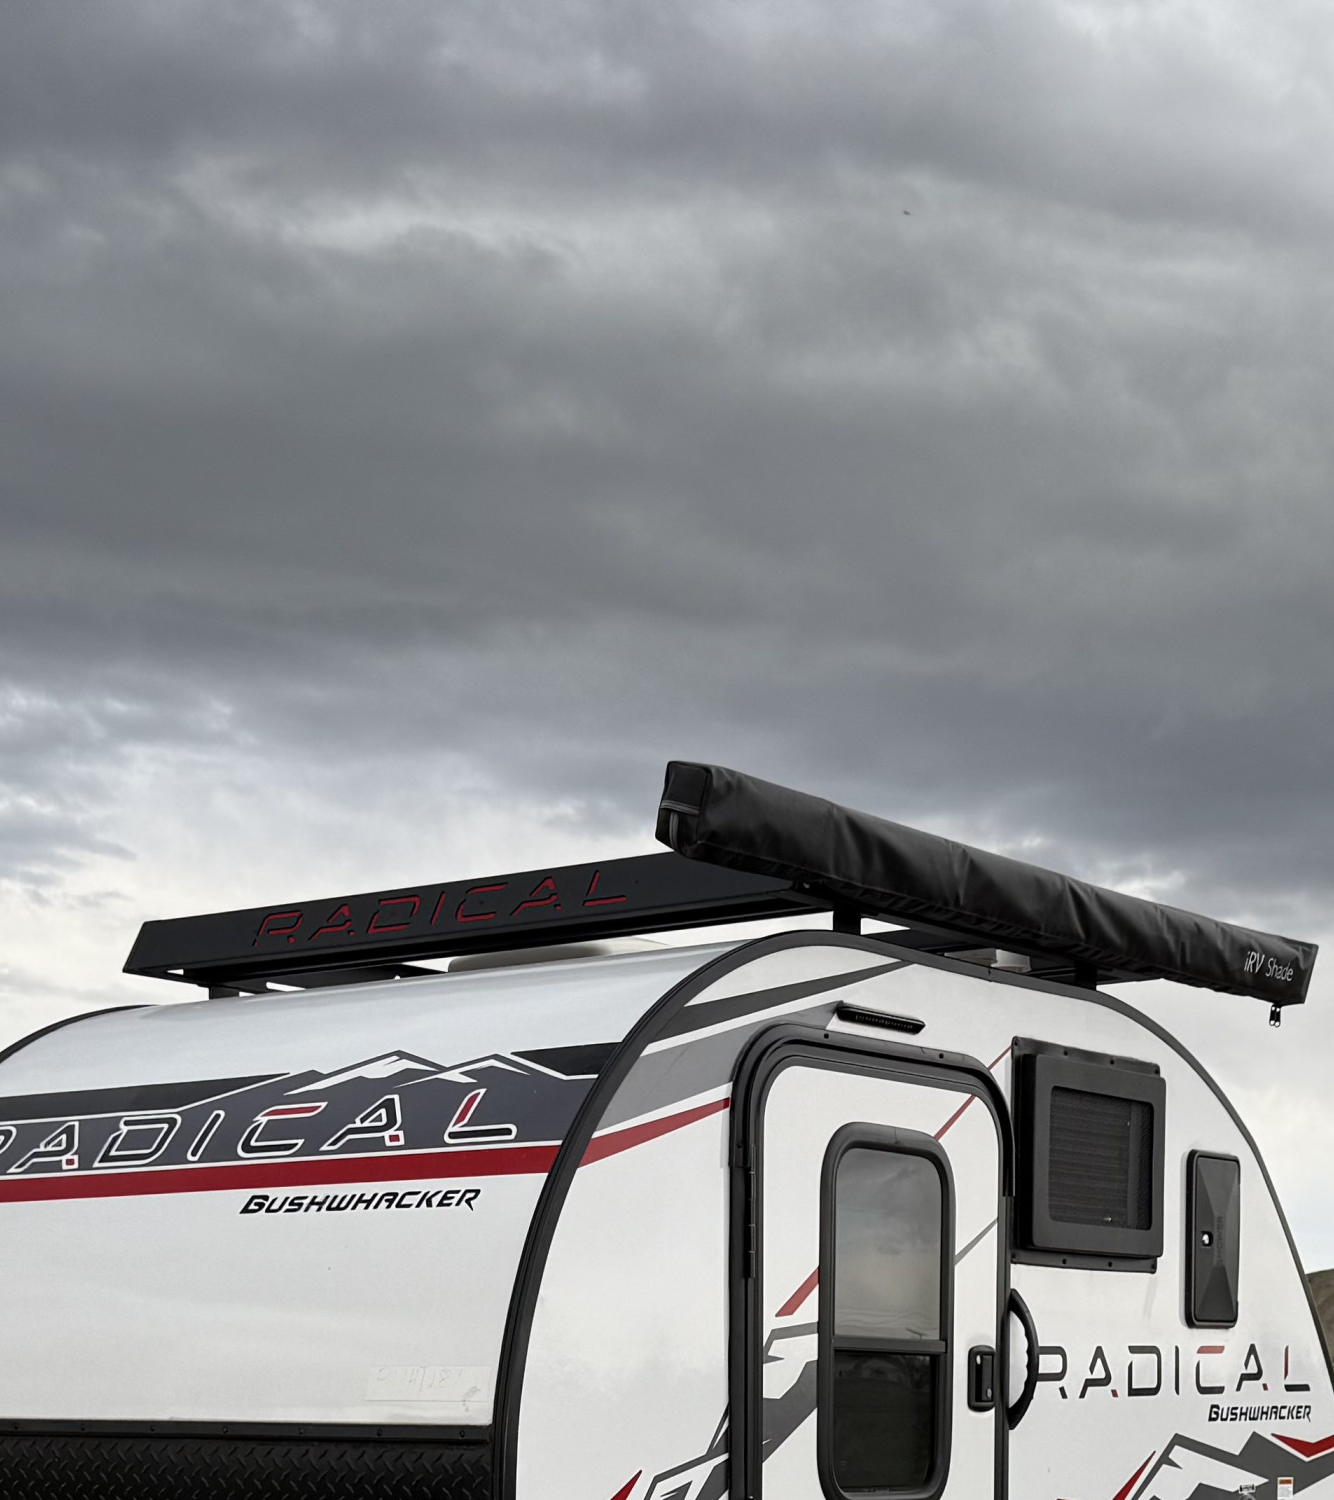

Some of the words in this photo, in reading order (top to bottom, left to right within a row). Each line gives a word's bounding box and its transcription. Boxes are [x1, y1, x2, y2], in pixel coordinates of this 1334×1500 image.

[252, 869, 627, 947] RADICAL
[1243, 951, 1265, 974] iRV
[1265, 957, 1294, 981] Shade
[238, 1187, 482, 1215] BUSHWHACKER
[1036, 1342, 1312, 1400] RADICAL
[1207, 1403, 1312, 1423] BUSHWHACKER
